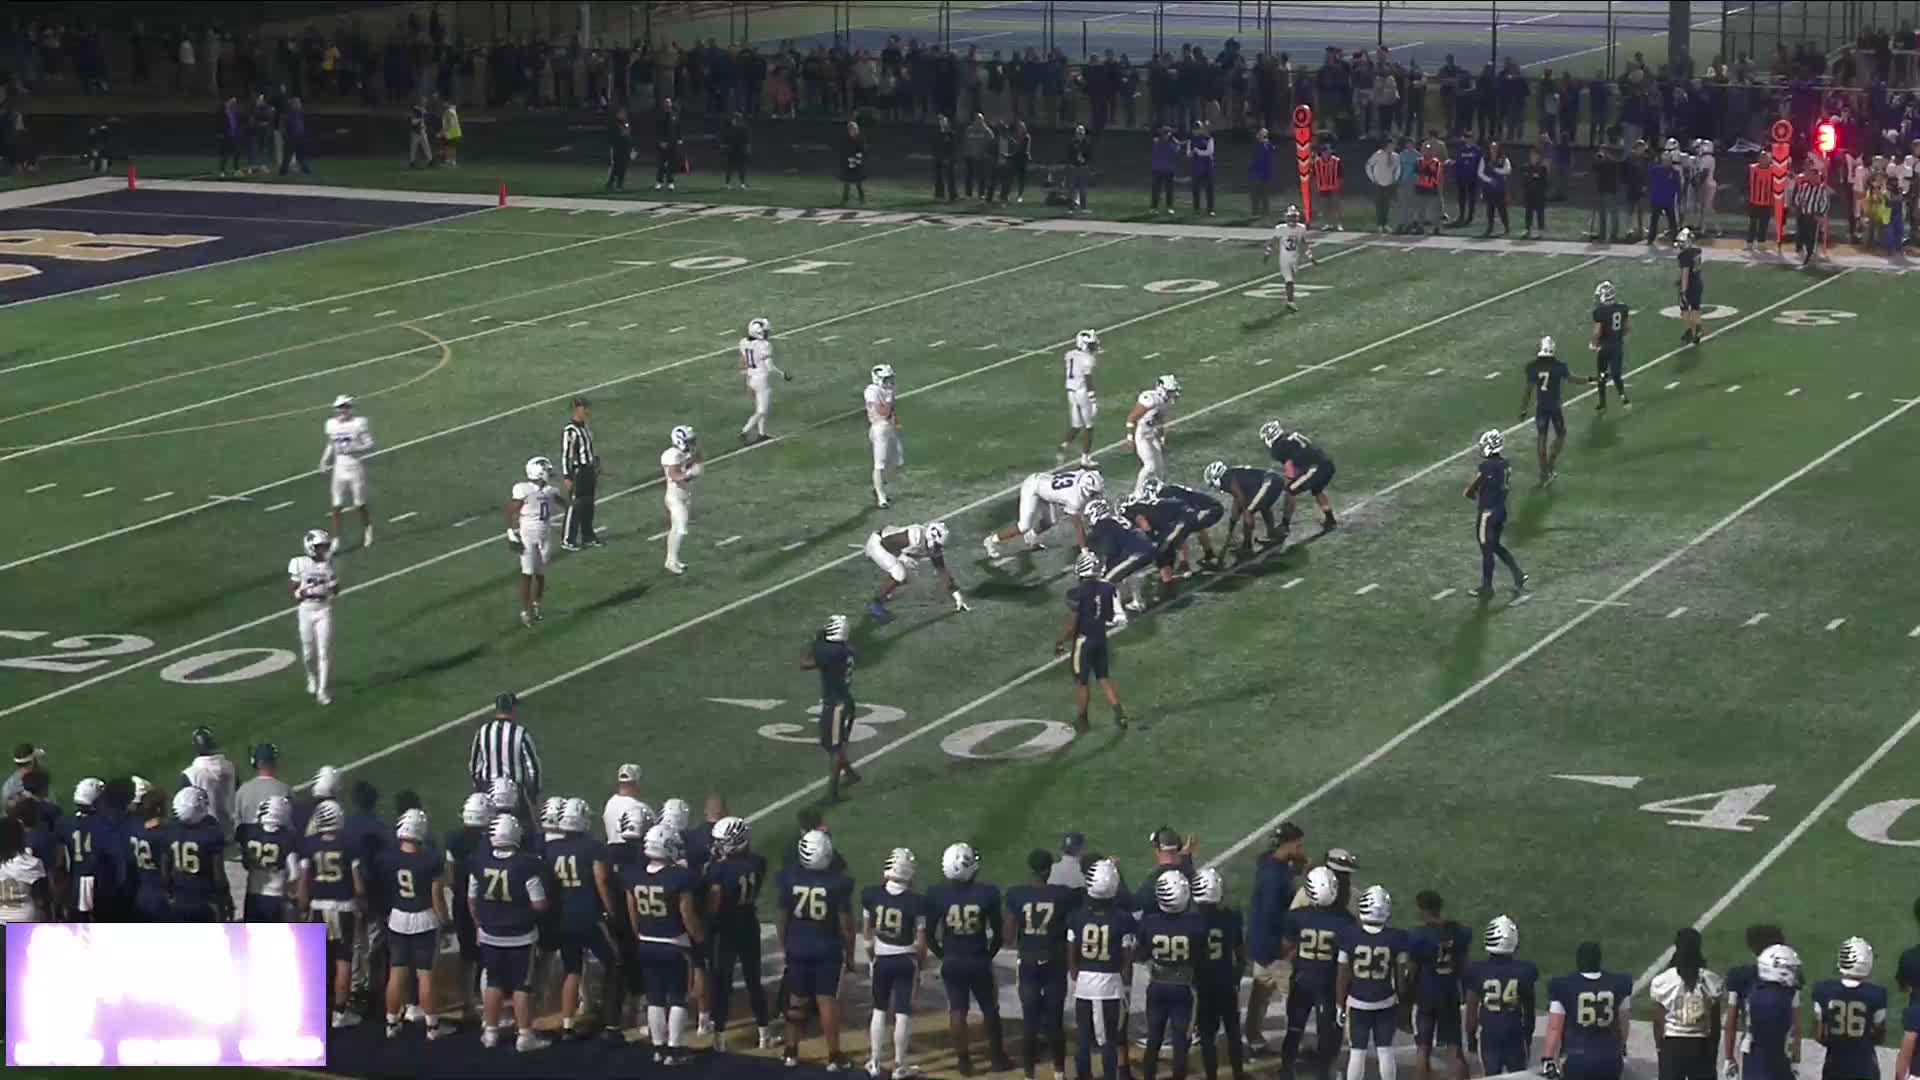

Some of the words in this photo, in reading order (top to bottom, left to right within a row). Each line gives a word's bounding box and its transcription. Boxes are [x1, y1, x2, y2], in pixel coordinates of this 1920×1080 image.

[1612, 311, 1622, 331] 8
[1537, 371, 1550, 391] 7
[169, 841, 200, 874] 16
[313, 850, 342, 882] 15
[553, 855, 582, 888] 41
[397, 868, 416, 899] 9
[483, 867, 512, 902] 71
[633, 884, 667, 918] 65
[792, 886, 829, 921] 76
[1022, 901, 1055, 936] 17
[1298, 927, 1336, 961] 25
[1352, 944, 1391, 980] 23
[1482, 978, 1519, 1012] 24
[1576, 990, 1615, 1028] 63
[1827, 999, 1867, 1038] 36
